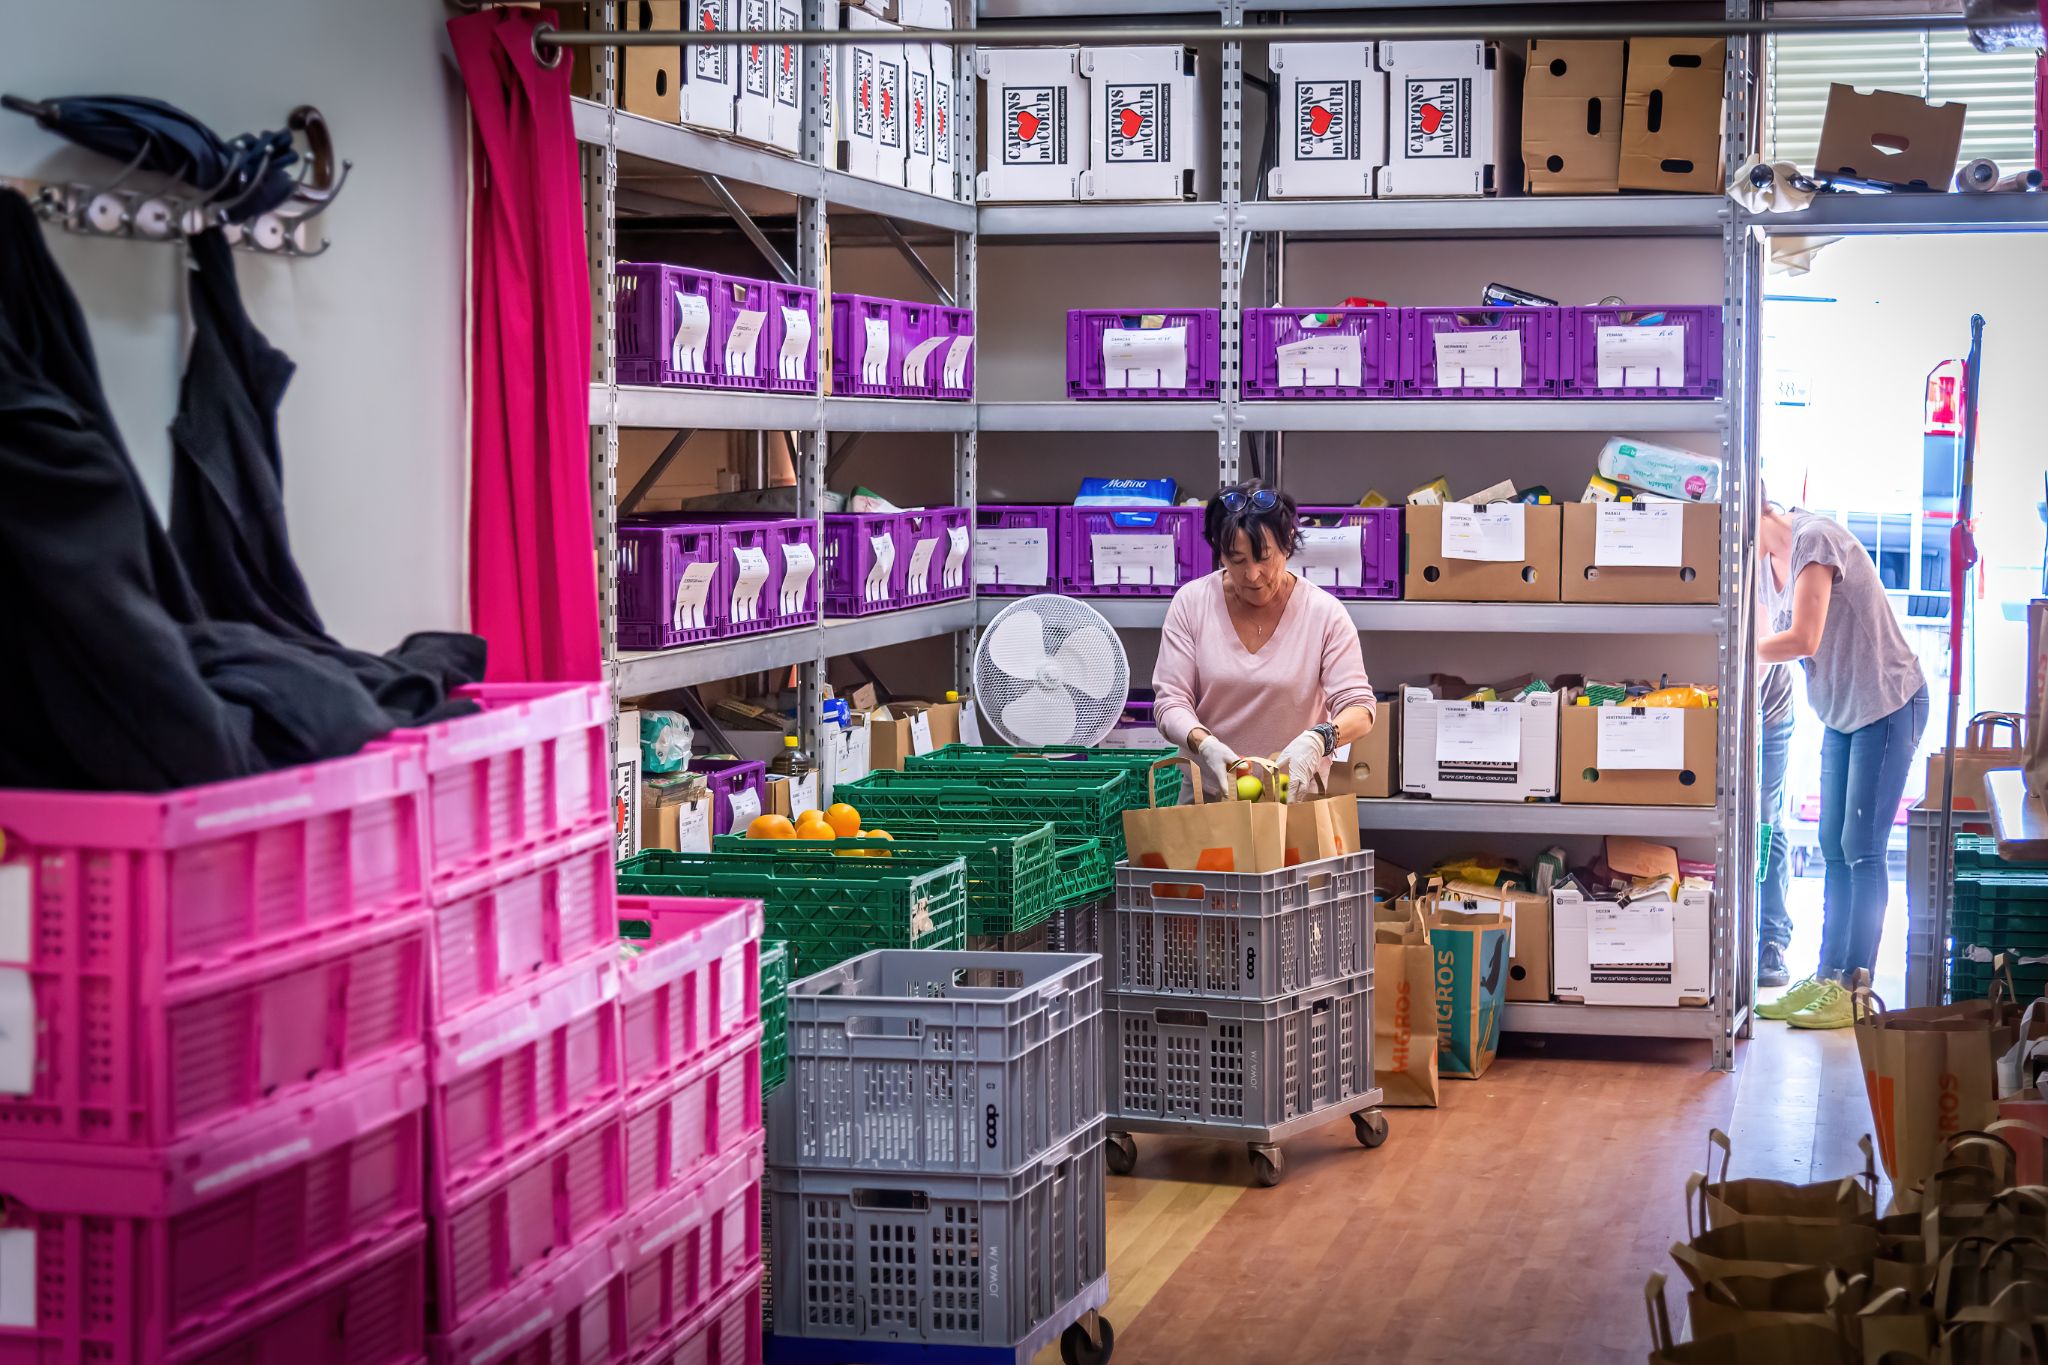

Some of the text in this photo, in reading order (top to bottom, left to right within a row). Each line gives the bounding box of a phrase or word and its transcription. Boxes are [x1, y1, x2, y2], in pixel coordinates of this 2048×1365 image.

[1008, 92, 1021, 160] CARTONS
[1036, 92, 1050, 159] DU COEUR
[1111, 89, 1124, 158] CARTONS
[1140, 89, 1154, 157] DU COEUR
[1300, 86, 1314, 155] CARTONS
[1329, 86, 1344, 155] DU COEUR
[1410, 84, 1424, 154] CARTONS
[1440, 84, 1454, 153] DU COEUR
[1102, 479, 1147, 489] Molfina
[1246, 946, 1257, 980] coop
[1392, 980, 1411, 1072] MIGROS
[986, 1103, 999, 1149] coop
[1939, 1073, 1959, 1133] ROS
